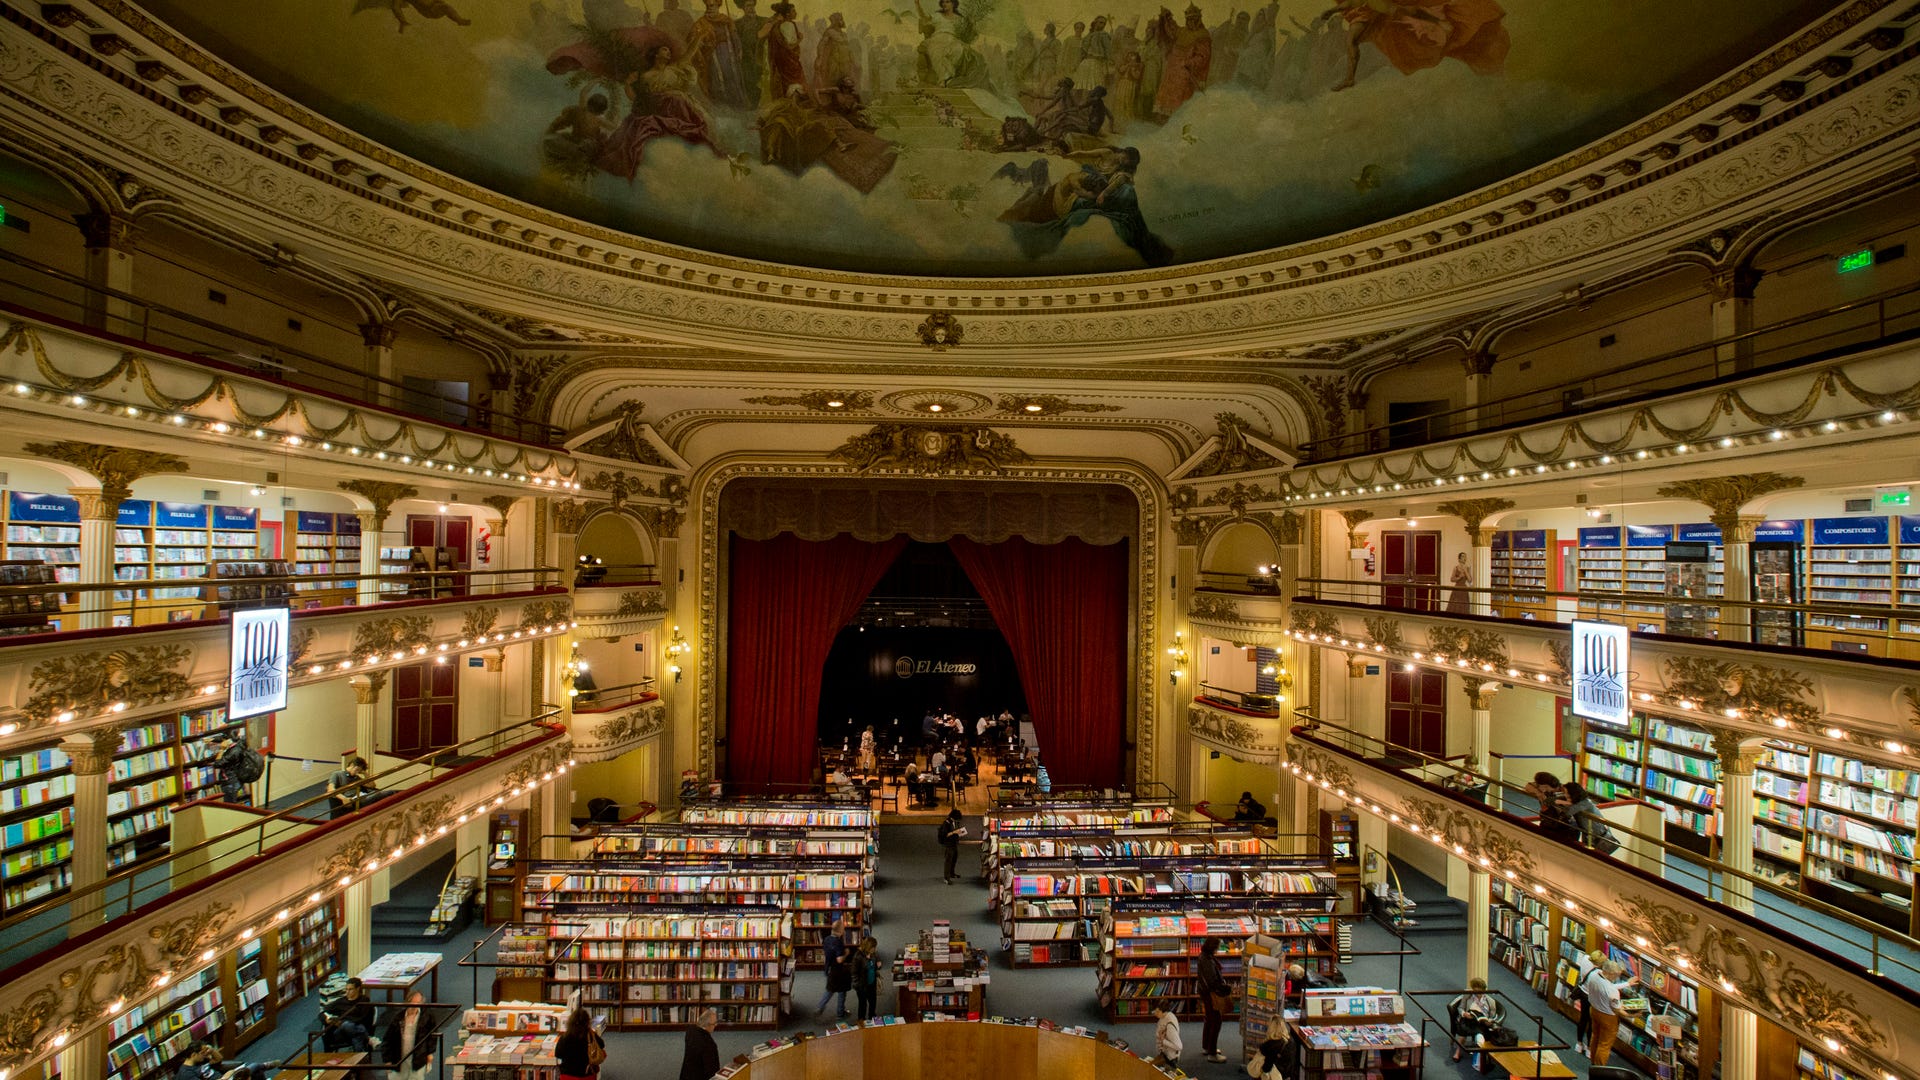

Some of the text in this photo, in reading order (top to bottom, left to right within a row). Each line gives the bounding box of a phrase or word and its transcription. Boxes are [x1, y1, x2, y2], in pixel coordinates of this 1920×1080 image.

[30, 503, 65, 511] PELICULAS
[241, 619, 279, 669] 100
[1582, 633, 1618, 679] 100
[915, 660, 976, 673] El Ateneo
[234, 676, 283, 702] EL ATENEO
[1577, 685, 1625, 710] EL ATENEO
